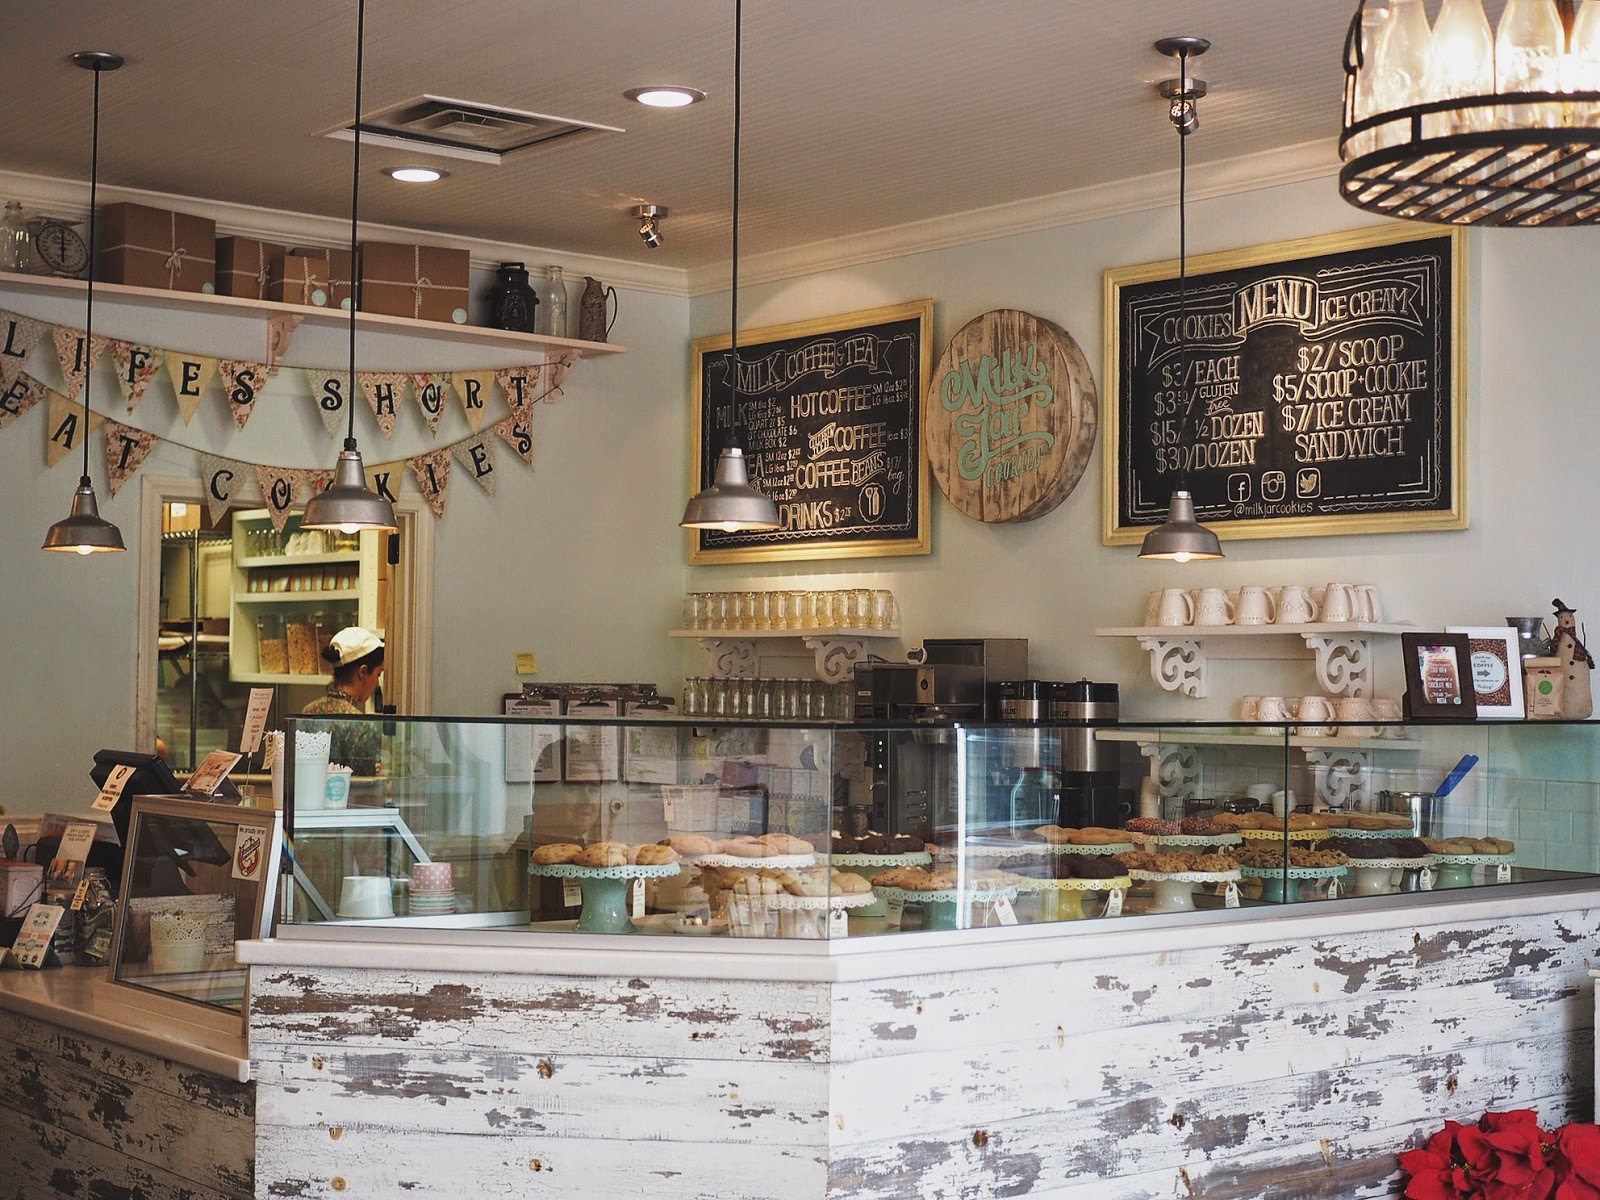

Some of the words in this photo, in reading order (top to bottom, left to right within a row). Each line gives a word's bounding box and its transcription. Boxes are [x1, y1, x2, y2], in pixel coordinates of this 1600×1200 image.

[1163, 313, 1232, 344] COOKIES
[1238, 279, 1314, 330] MENU
[1320, 295, 1349, 326] ICE
[1350, 287, 1410, 318] CREAM
[736, 352, 781, 392] MILK
[786, 342, 836, 380] COFFEE
[844, 336, 876, 366] TEA
[941, 345, 1054, 412] Milk
[320, 376, 527, 414] SHORT
[791, 392, 819, 419] HOT
[819, 385, 872, 415] COFFEE
[1199, 382, 1240, 399] GLUTEN
[777, 416, 786, 427] $5
[1211, 411, 1265, 441] DOZEN
[1348, 393, 1412, 426] CREAM
[0, 380, 140, 470] EAT
[210, 422, 532, 511] COKIES
[778, 437, 787, 448] $2
[789, 425, 798, 436] $6
[834, 422, 886, 452] COFFEE
[956, 402, 1055, 481] Jar
[1294, 426, 1406, 463] SANDWICH
[743, 453, 765, 479] EA
[795, 459, 850, 490] COFFEE
[852, 453, 884, 483] BEANS
[986, 443, 1045, 488] COOKIES
[779, 501, 832, 531] DRINKS
[1234, 501, 1314, 517] @milkjarcookies
